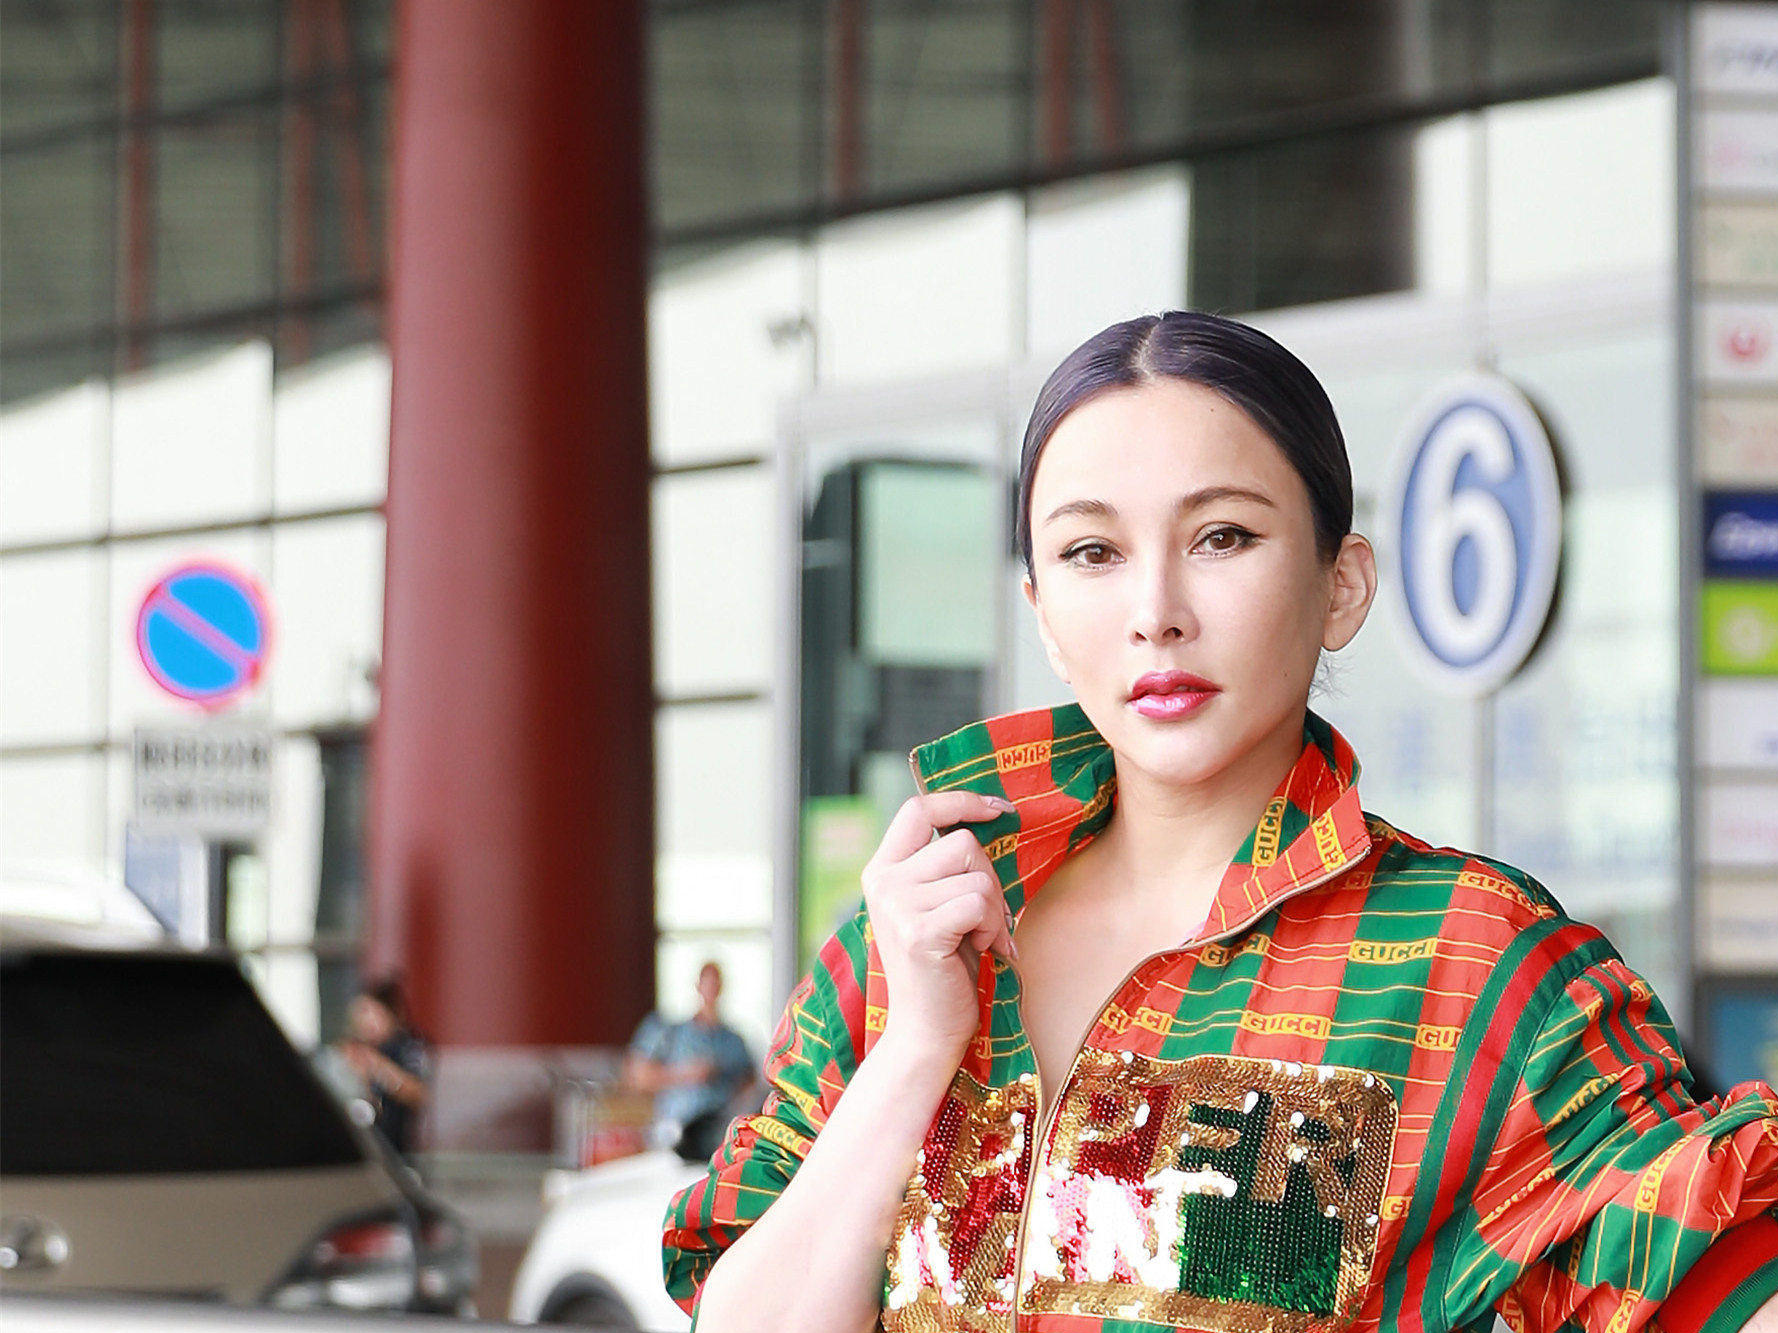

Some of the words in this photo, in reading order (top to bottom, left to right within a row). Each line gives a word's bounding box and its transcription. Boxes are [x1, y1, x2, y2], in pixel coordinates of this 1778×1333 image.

[1410, 412, 1517, 648] 6
[1353, 942, 1437, 962] GUCCI
[1246, 1015, 1331, 1037] GUCCI
